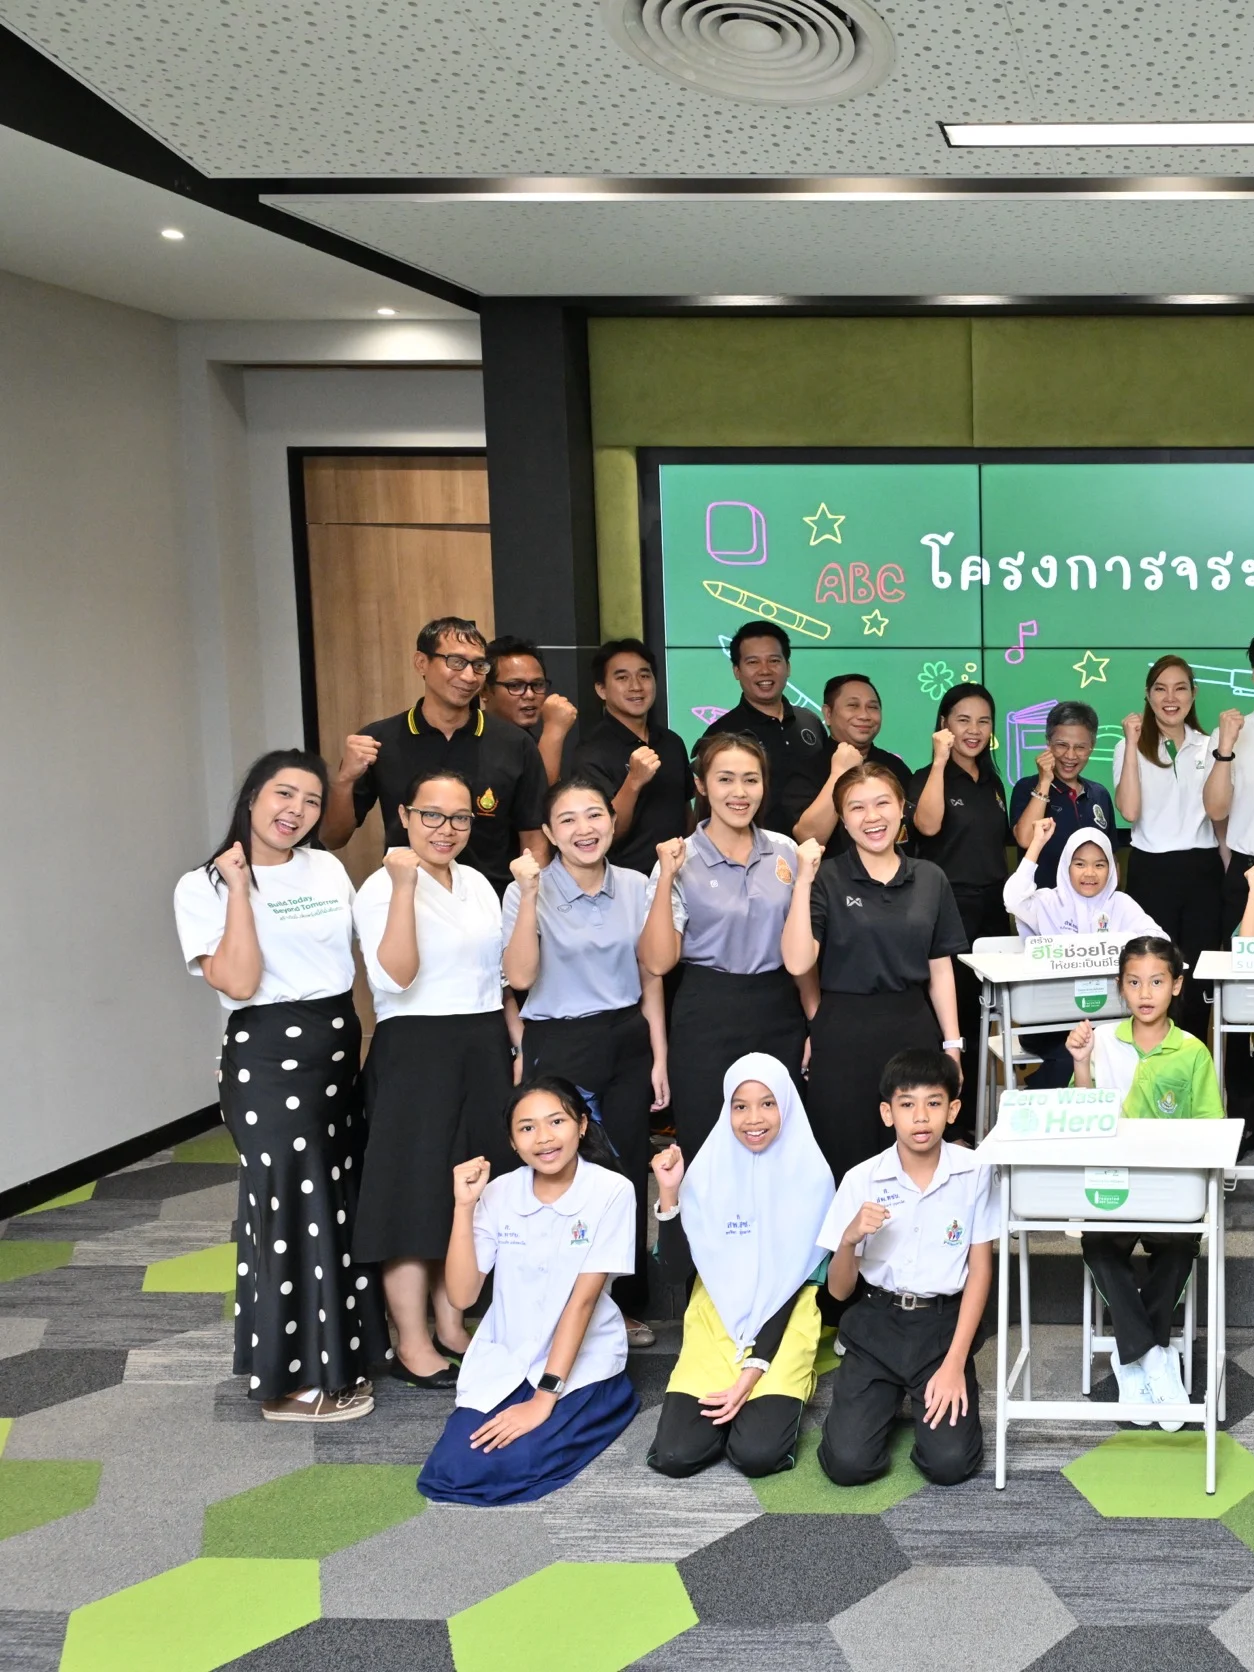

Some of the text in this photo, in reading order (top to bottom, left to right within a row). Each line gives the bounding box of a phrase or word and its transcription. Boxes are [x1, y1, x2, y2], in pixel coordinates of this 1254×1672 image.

[816, 562, 906, 604] ABC
[272, 906, 301, 914] Beyond
[301, 899, 339, 911] Tomorrow
[1003, 1089, 1116, 1107] Zero Waste
[1045, 1110, 1115, 1133] Hero
